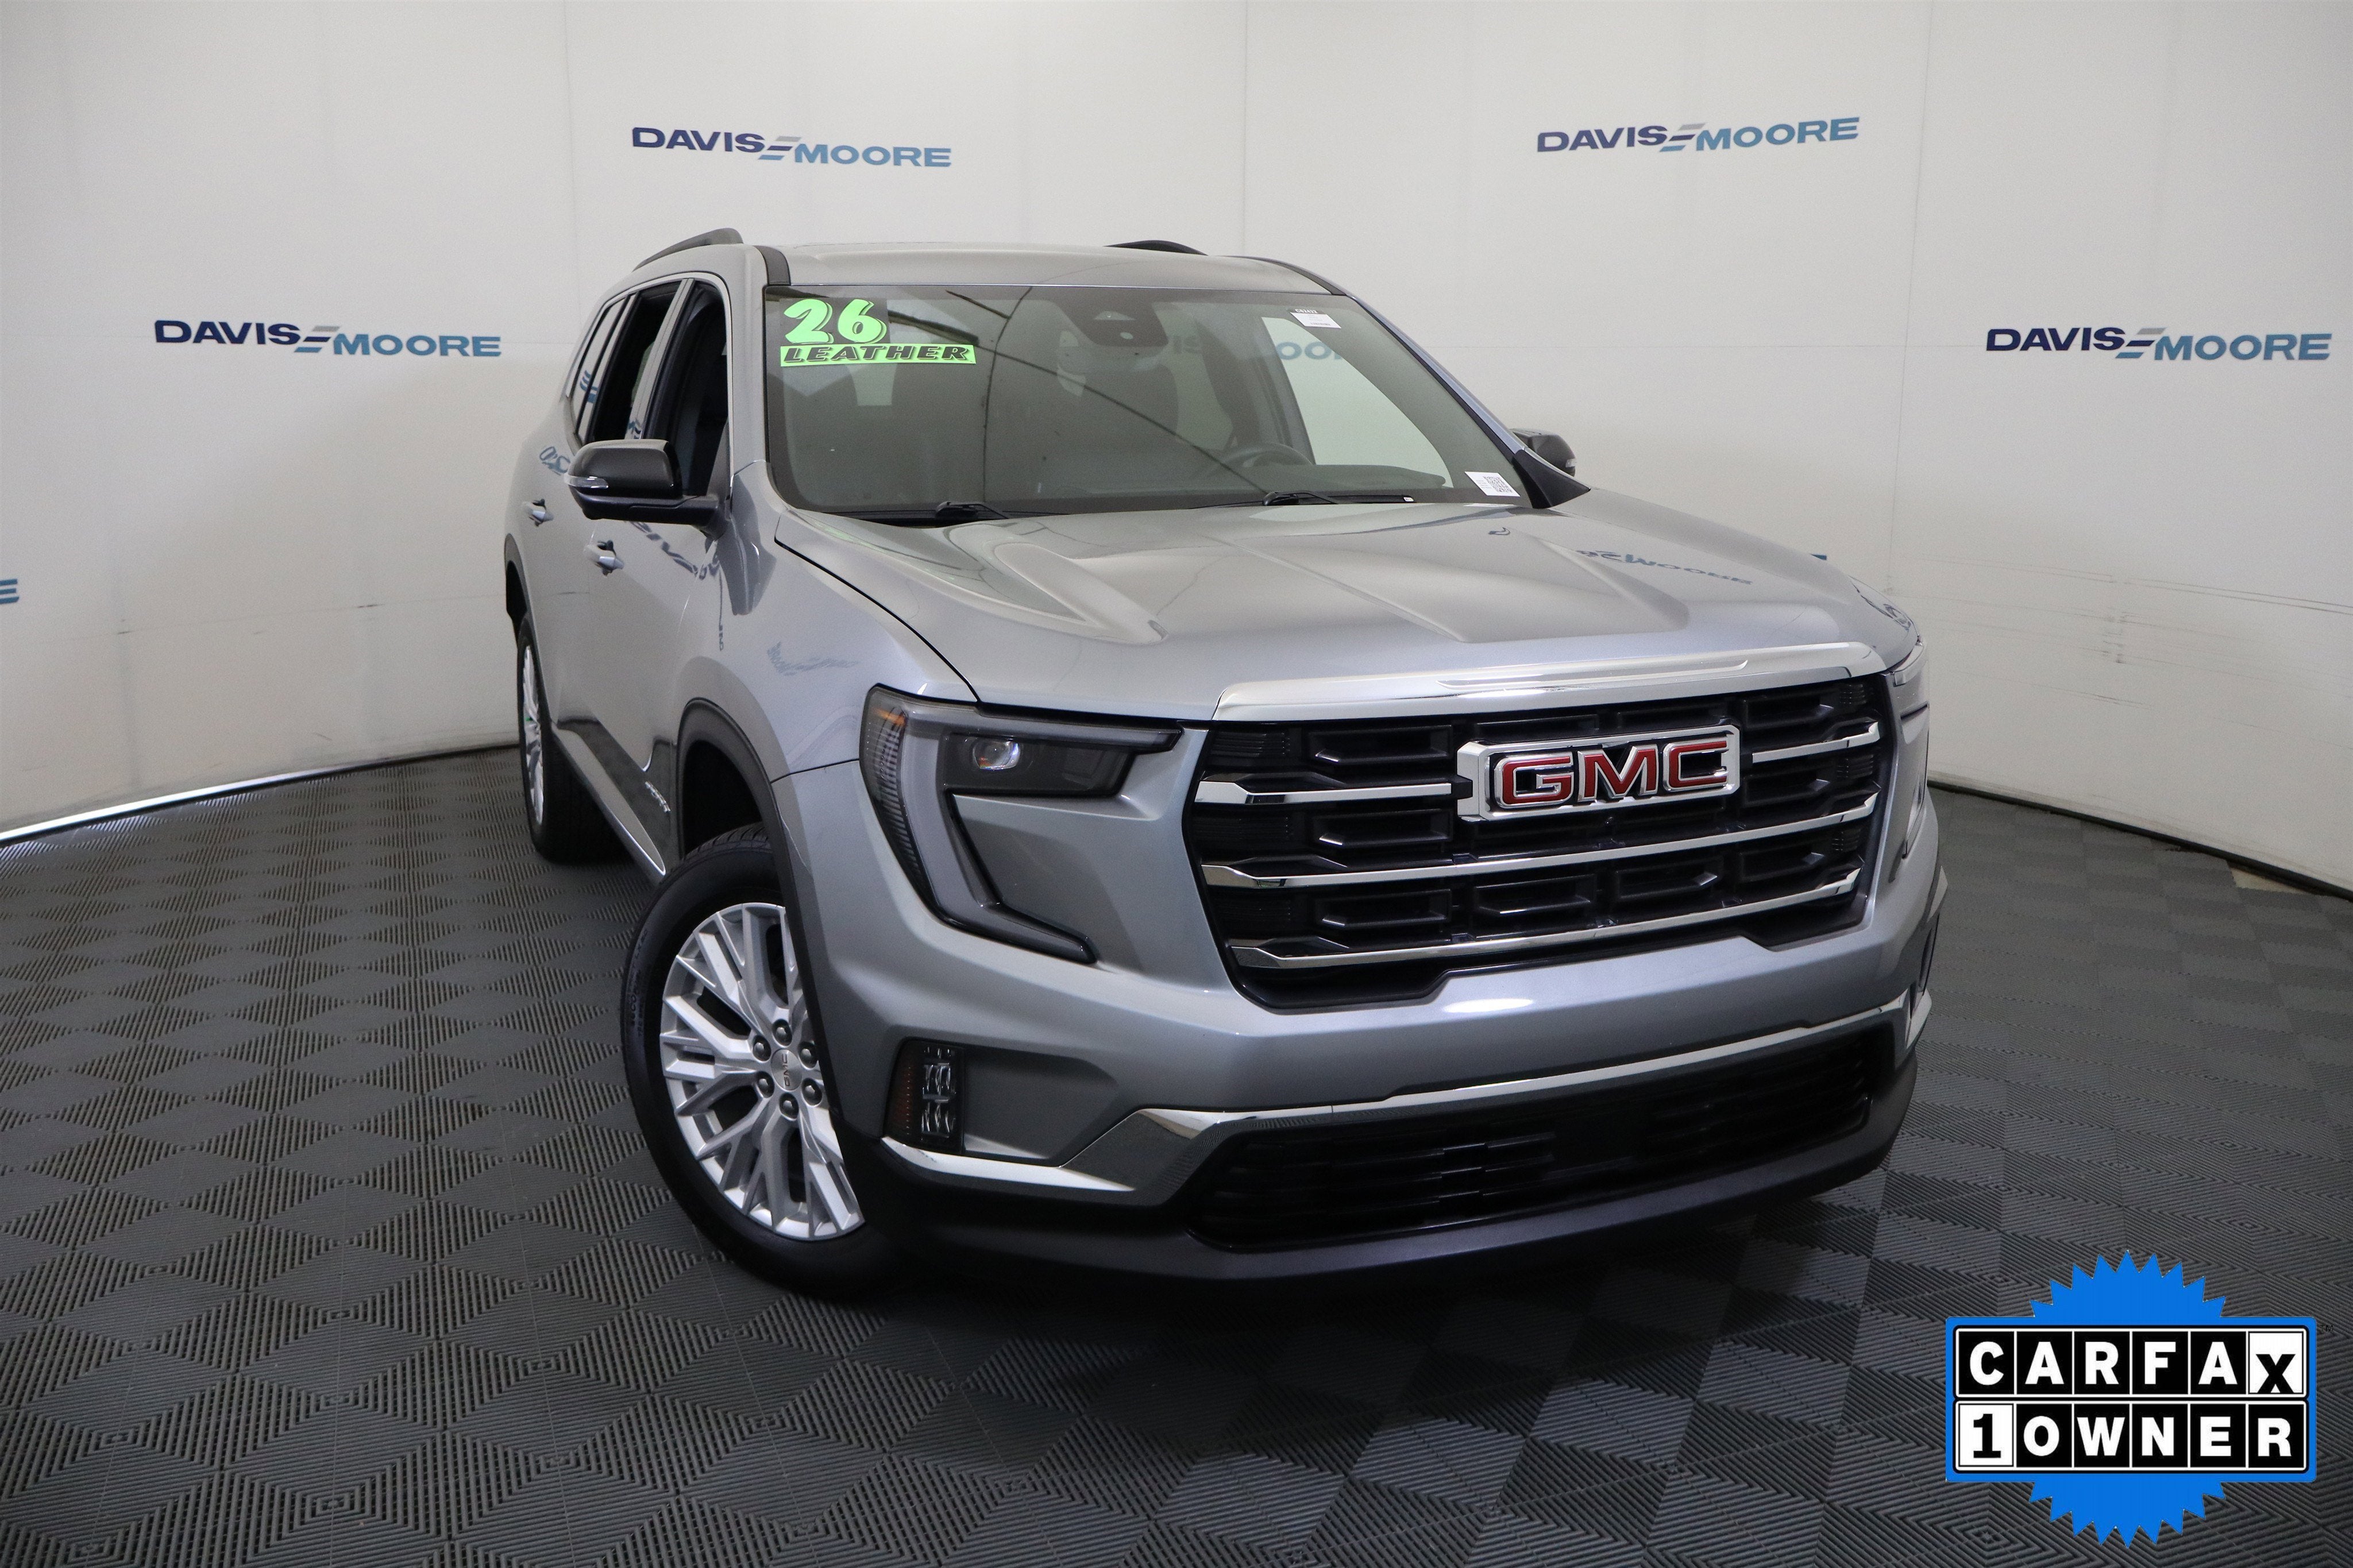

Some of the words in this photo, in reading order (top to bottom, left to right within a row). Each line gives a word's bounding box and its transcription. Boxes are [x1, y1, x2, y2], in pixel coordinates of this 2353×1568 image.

[632, 126, 766, 153] DAVIS
[794, 143, 951, 167] MOORE
[1537, 125, 1668, 153] DAVIS
[1696, 117, 1860, 152] MOORE
[154, 319, 300, 345] DAVIS
[333, 333, 502, 357] MOORE
[784, 298, 888, 345] 26
[784, 346, 968, 362] LEATHER
[1986, 326, 2126, 352] DAVIS
[2154, 333, 2332, 361] MOORE
[1494, 736, 1729, 810] GMC
[781, 1053, 790, 1087] GMC
